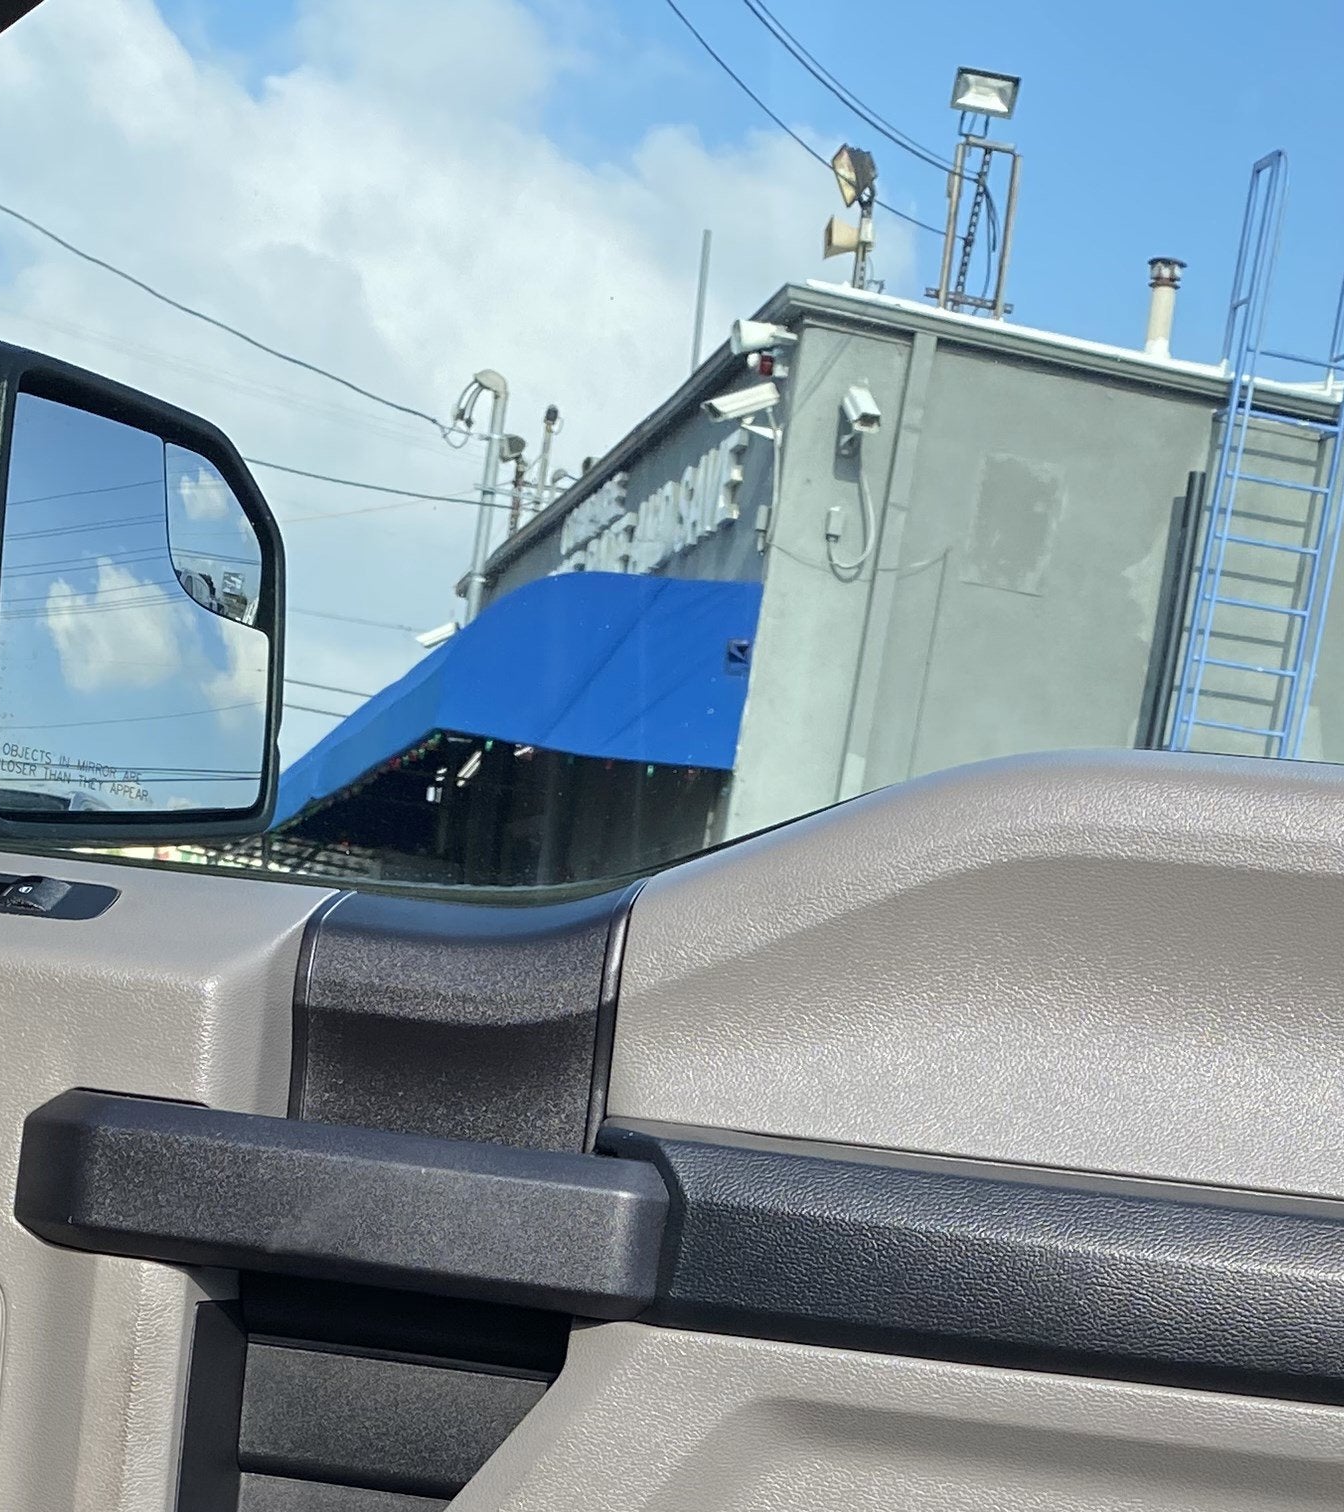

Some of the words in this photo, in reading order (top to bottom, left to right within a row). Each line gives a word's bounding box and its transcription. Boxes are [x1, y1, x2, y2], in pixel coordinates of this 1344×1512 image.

[2, 742, 52, 765] OBJECTS
[58, 755, 71, 768] IN
[77, 758, 118, 779] MIRROR
[122, 771, 143, 786] ARE
[43, 766, 72, 785] THAN
[78, 774, 104, 792] THEY
[109, 783, 150, 803] APPEAR
